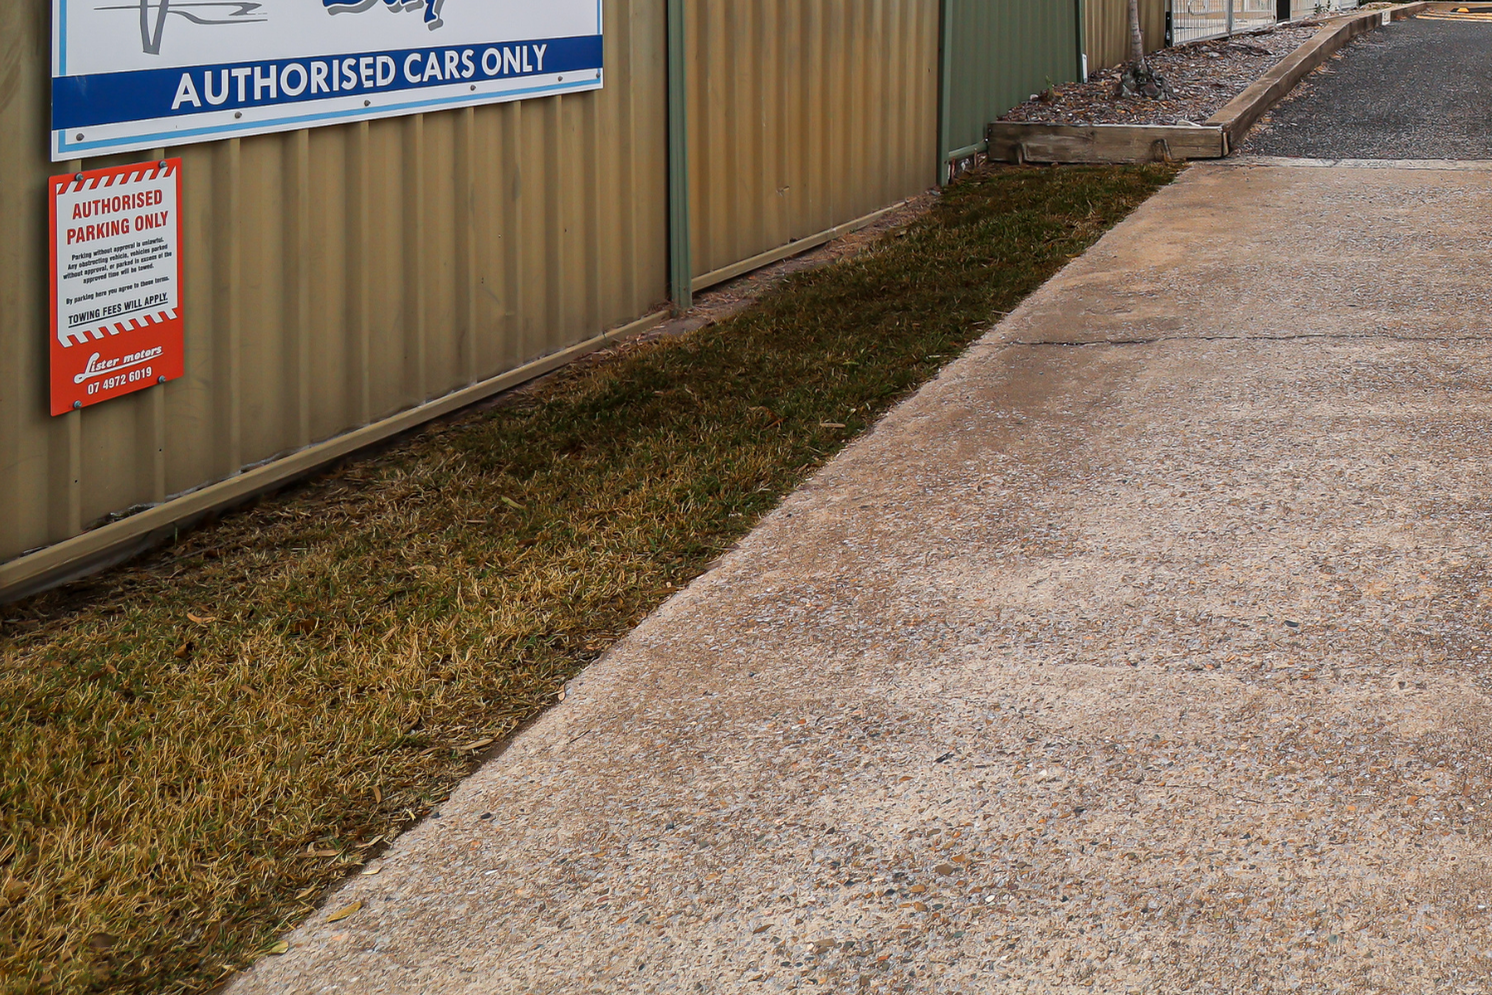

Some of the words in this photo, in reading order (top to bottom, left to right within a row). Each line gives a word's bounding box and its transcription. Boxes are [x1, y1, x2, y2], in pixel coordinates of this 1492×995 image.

[171, 56, 396, 109] AUTHORISED
[404, 49, 475, 84] CARS
[481, 44, 548, 76] ONLY
[72, 189, 162, 220] AUTHORISED
[66, 218, 130, 245] PARKING
[134, 210, 169, 233] ONLY
[68, 263, 77, 271] Any
[79, 257, 108, 268] obstructing
[130, 248, 150, 257] vehicles
[151, 244, 168, 254] parked
[71, 252, 92, 261] Parking
[93, 247, 112, 256] without
[113, 242, 135, 253] approval
[63, 271, 83, 280] without
[116, 258, 134, 269] parked
[83, 273, 107, 284] approved
[66, 297, 73, 305] By
[74, 292, 94, 303] parking
[95, 290, 107, 298] here
[108, 287, 117, 296] you
[118, 284, 133, 293] agree
[68, 309, 100, 325] TOWING
[102, 303, 122, 316] FEES
[123, 298, 142, 311] WILL
[144, 292, 168, 305] APPLY.
[74, 352, 119, 384] Lister
[123, 346, 162, 363] motors
[87, 381, 100, 395] 07
[102, 373, 127, 390] 4972
[128, 366, 152, 382] 6019
